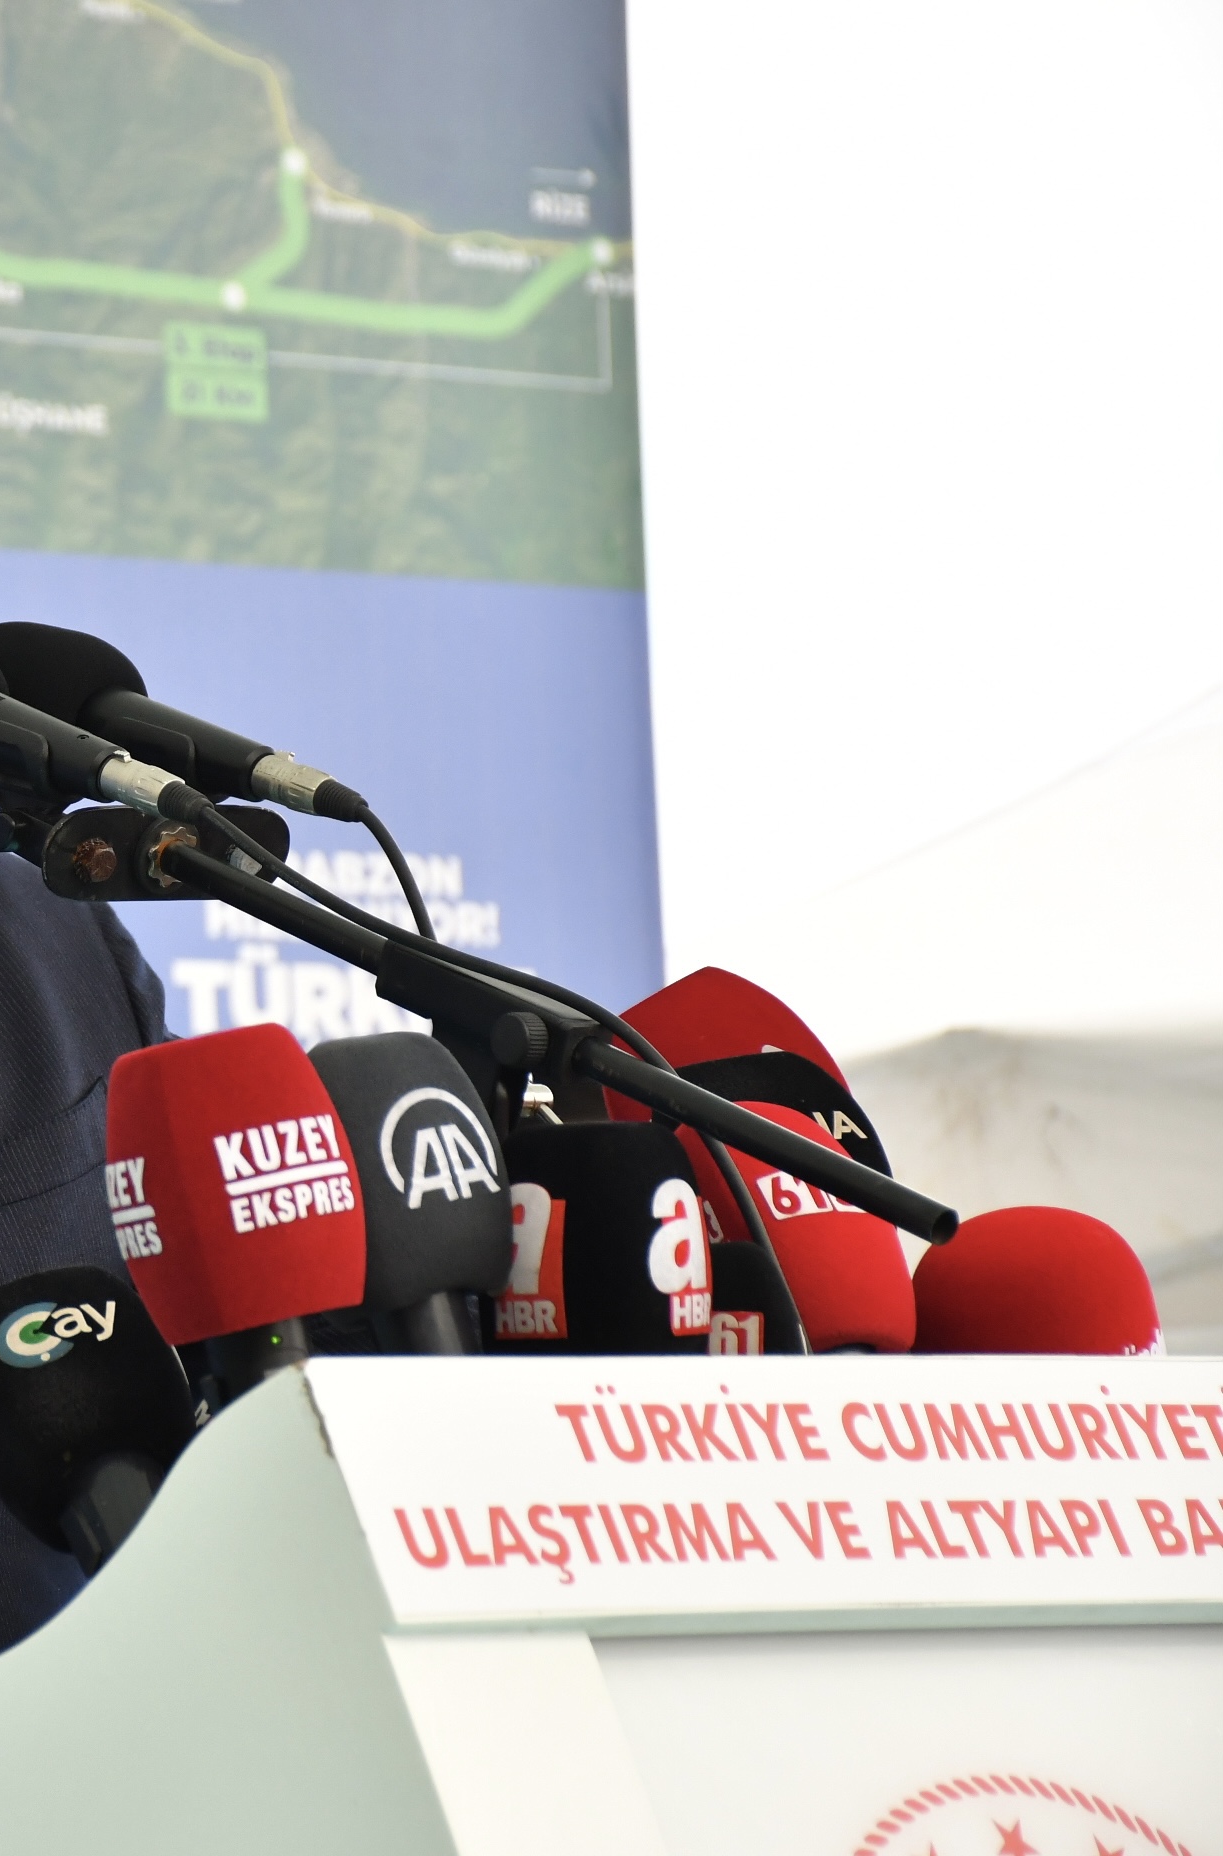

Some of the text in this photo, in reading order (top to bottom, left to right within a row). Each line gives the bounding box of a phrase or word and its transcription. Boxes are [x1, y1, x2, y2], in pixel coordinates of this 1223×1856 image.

[213, 1113, 341, 1183] KUZEY
[407, 1123, 502, 1210] AA
[229, 1175, 355, 1235] EKSPRES
[1, 1300, 117, 1363] Çay
[495, 1300, 558, 1334] HBR
[554, 1384, 1223, 1463] TÜRKİYE CUMHURİYET
[393, 1498, 1223, 1585] ULAŞTIRMA VE ALTYAPI BA
